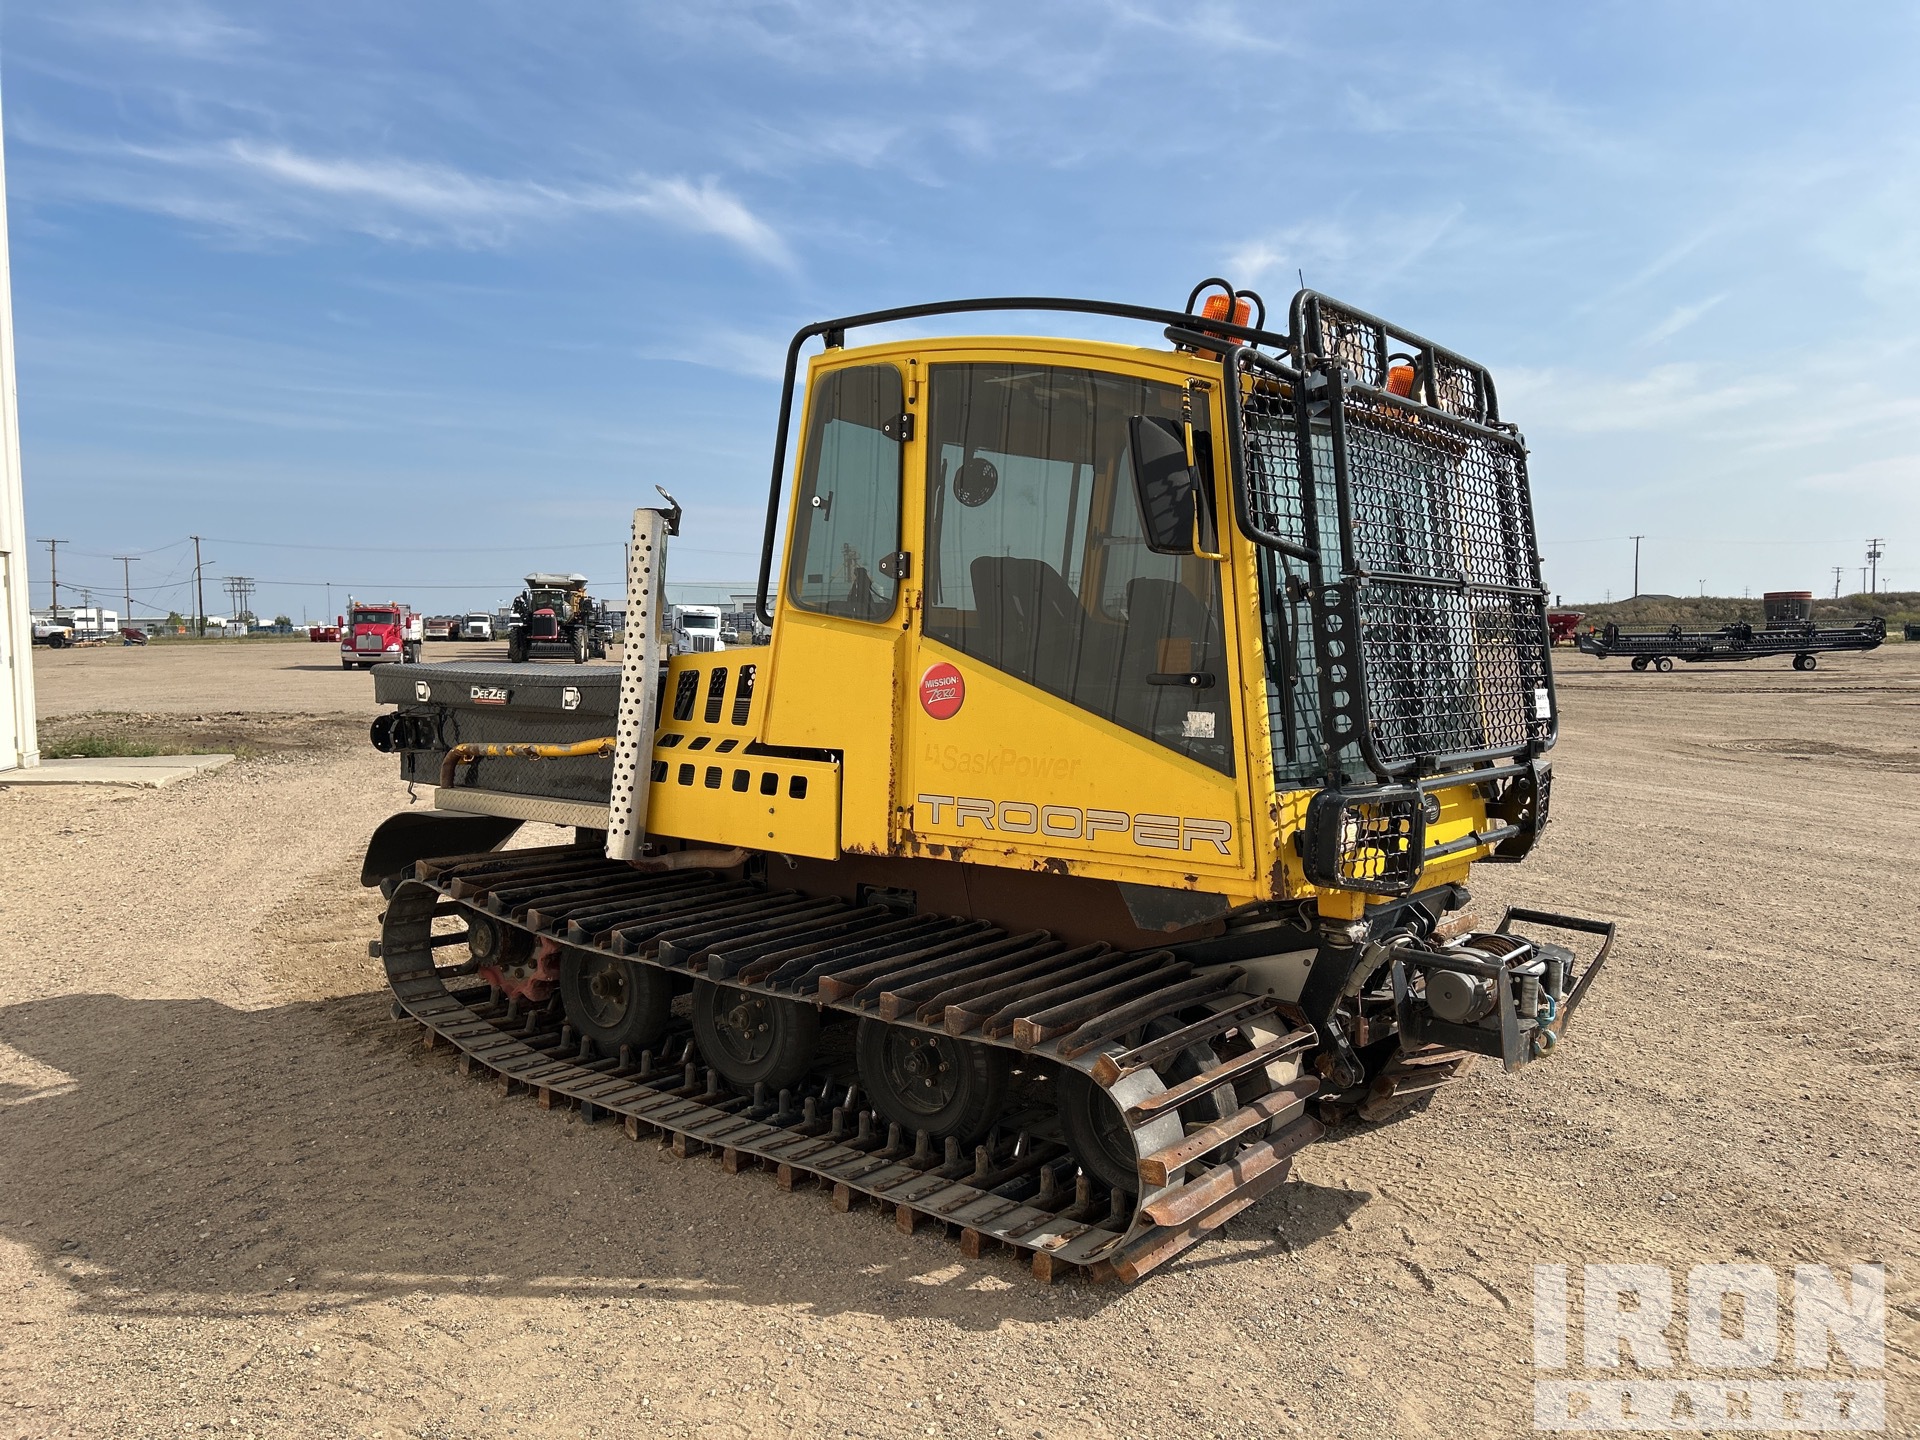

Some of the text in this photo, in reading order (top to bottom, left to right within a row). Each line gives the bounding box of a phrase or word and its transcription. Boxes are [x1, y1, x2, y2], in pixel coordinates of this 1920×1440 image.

[925, 676, 959, 688] MISSION:
[941, 744, 1081, 779] SaskPower
[918, 793, 1231, 855] TROOPER
